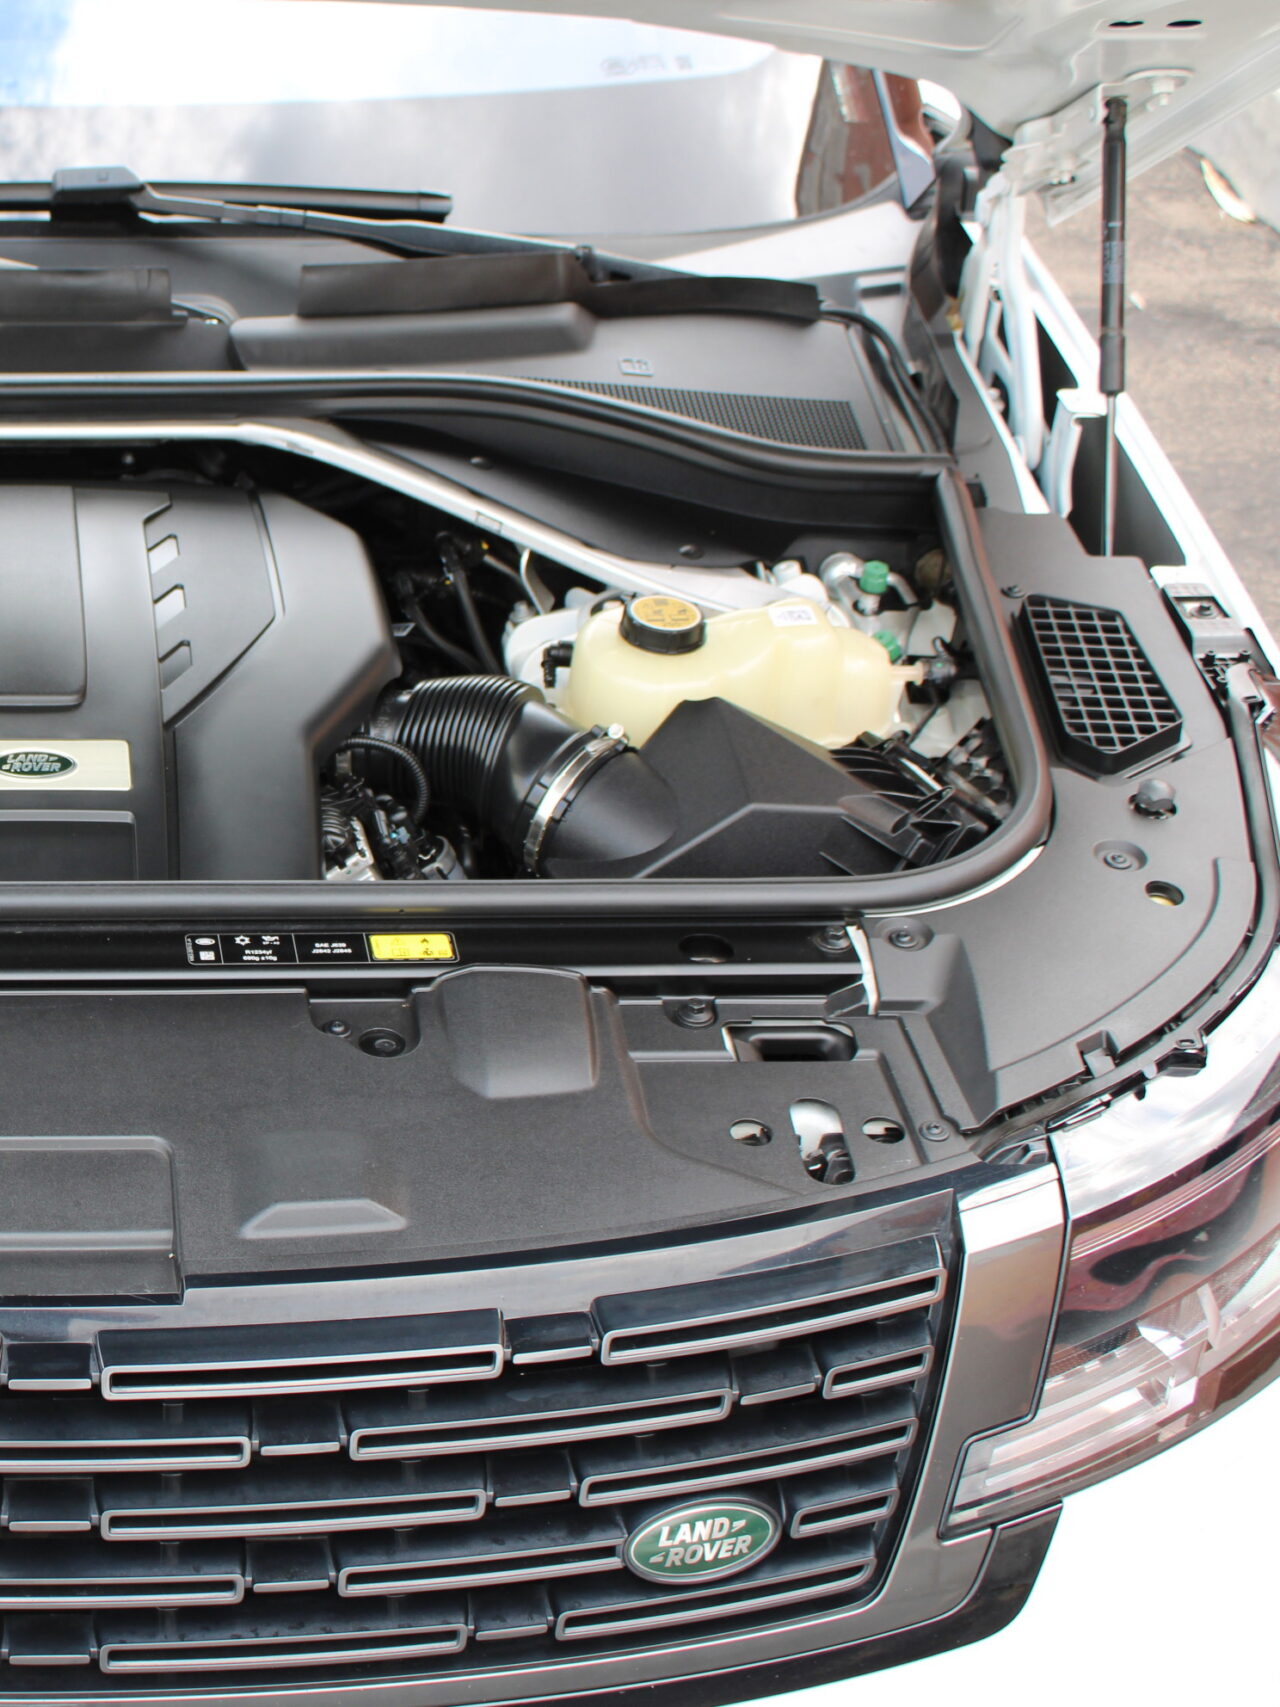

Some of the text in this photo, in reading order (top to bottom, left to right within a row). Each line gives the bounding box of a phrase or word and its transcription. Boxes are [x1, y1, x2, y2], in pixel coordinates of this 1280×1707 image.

[7, 753, 48, 763] LAND
[10, 762, 61, 772] ROVER
[657, 1516, 731, 1548] LAND
[664, 1534, 753, 1568] ROVER
